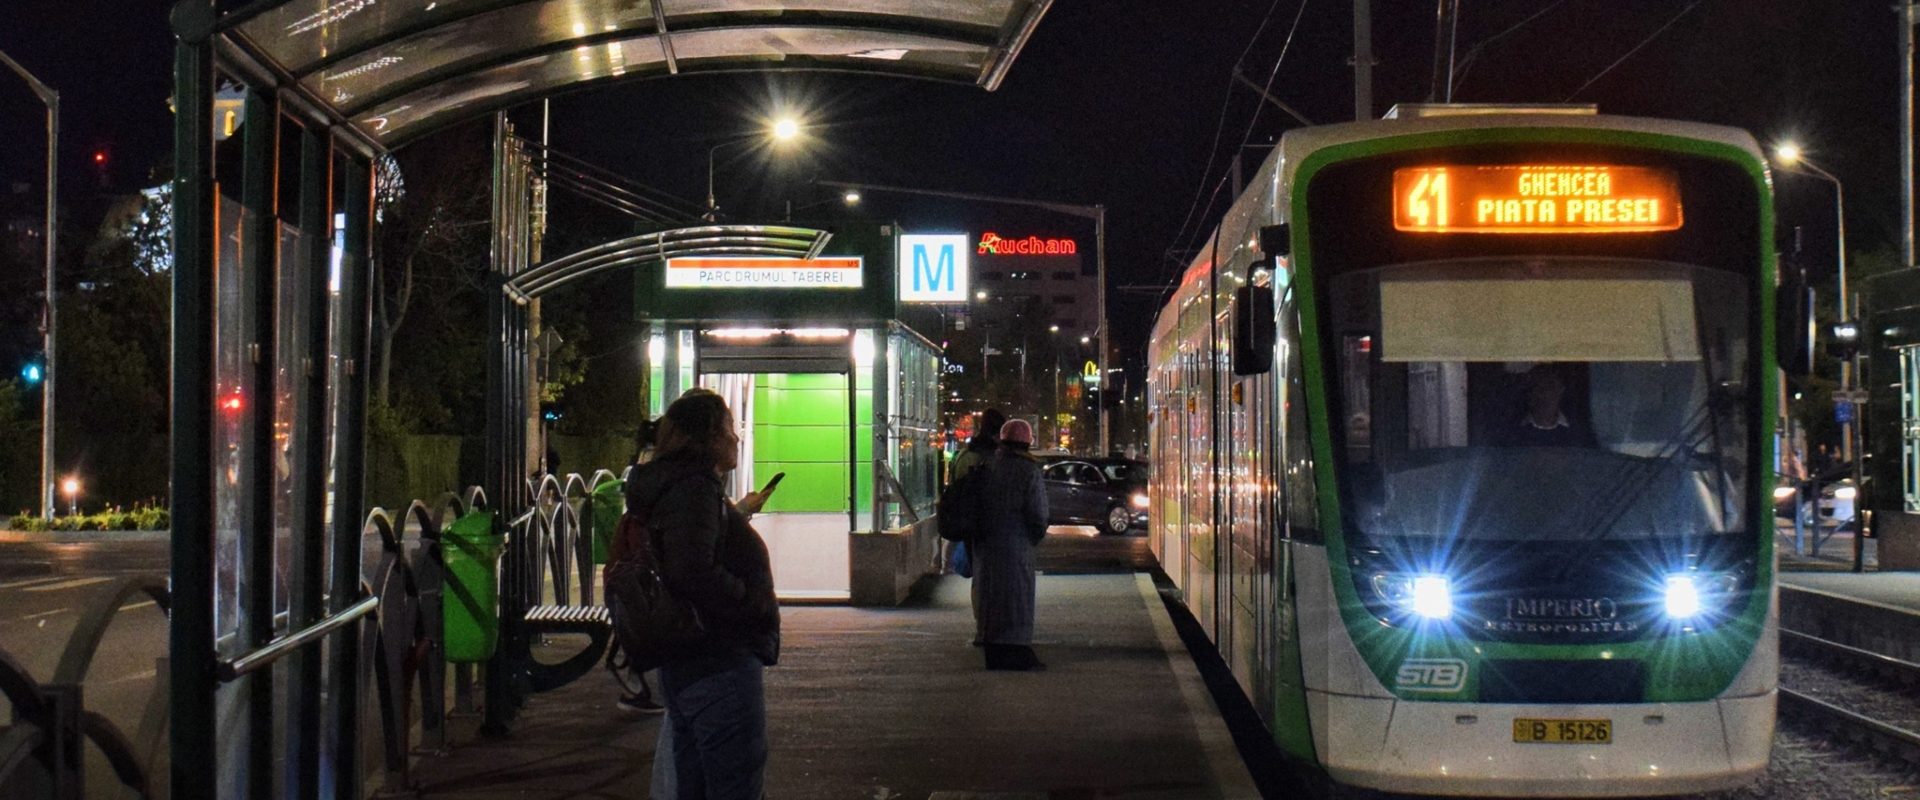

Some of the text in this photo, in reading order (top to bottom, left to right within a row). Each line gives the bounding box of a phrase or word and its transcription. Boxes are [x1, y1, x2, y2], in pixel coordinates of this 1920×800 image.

[1518, 172, 1611, 196] GHENCEA
[1408, 173, 1448, 226] 41
[1477, 199, 1658, 223] PIATA PRESEI
[977, 232, 1076, 255] Auchan
[699, 271, 844, 283] PARC DRUMUL TABEREI
[912, 243, 955, 293] M
[1505, 597, 1617, 621] IMPERIO
[1396, 664, 1459, 685] STB
[1532, 722, 1608, 741] B 15126
